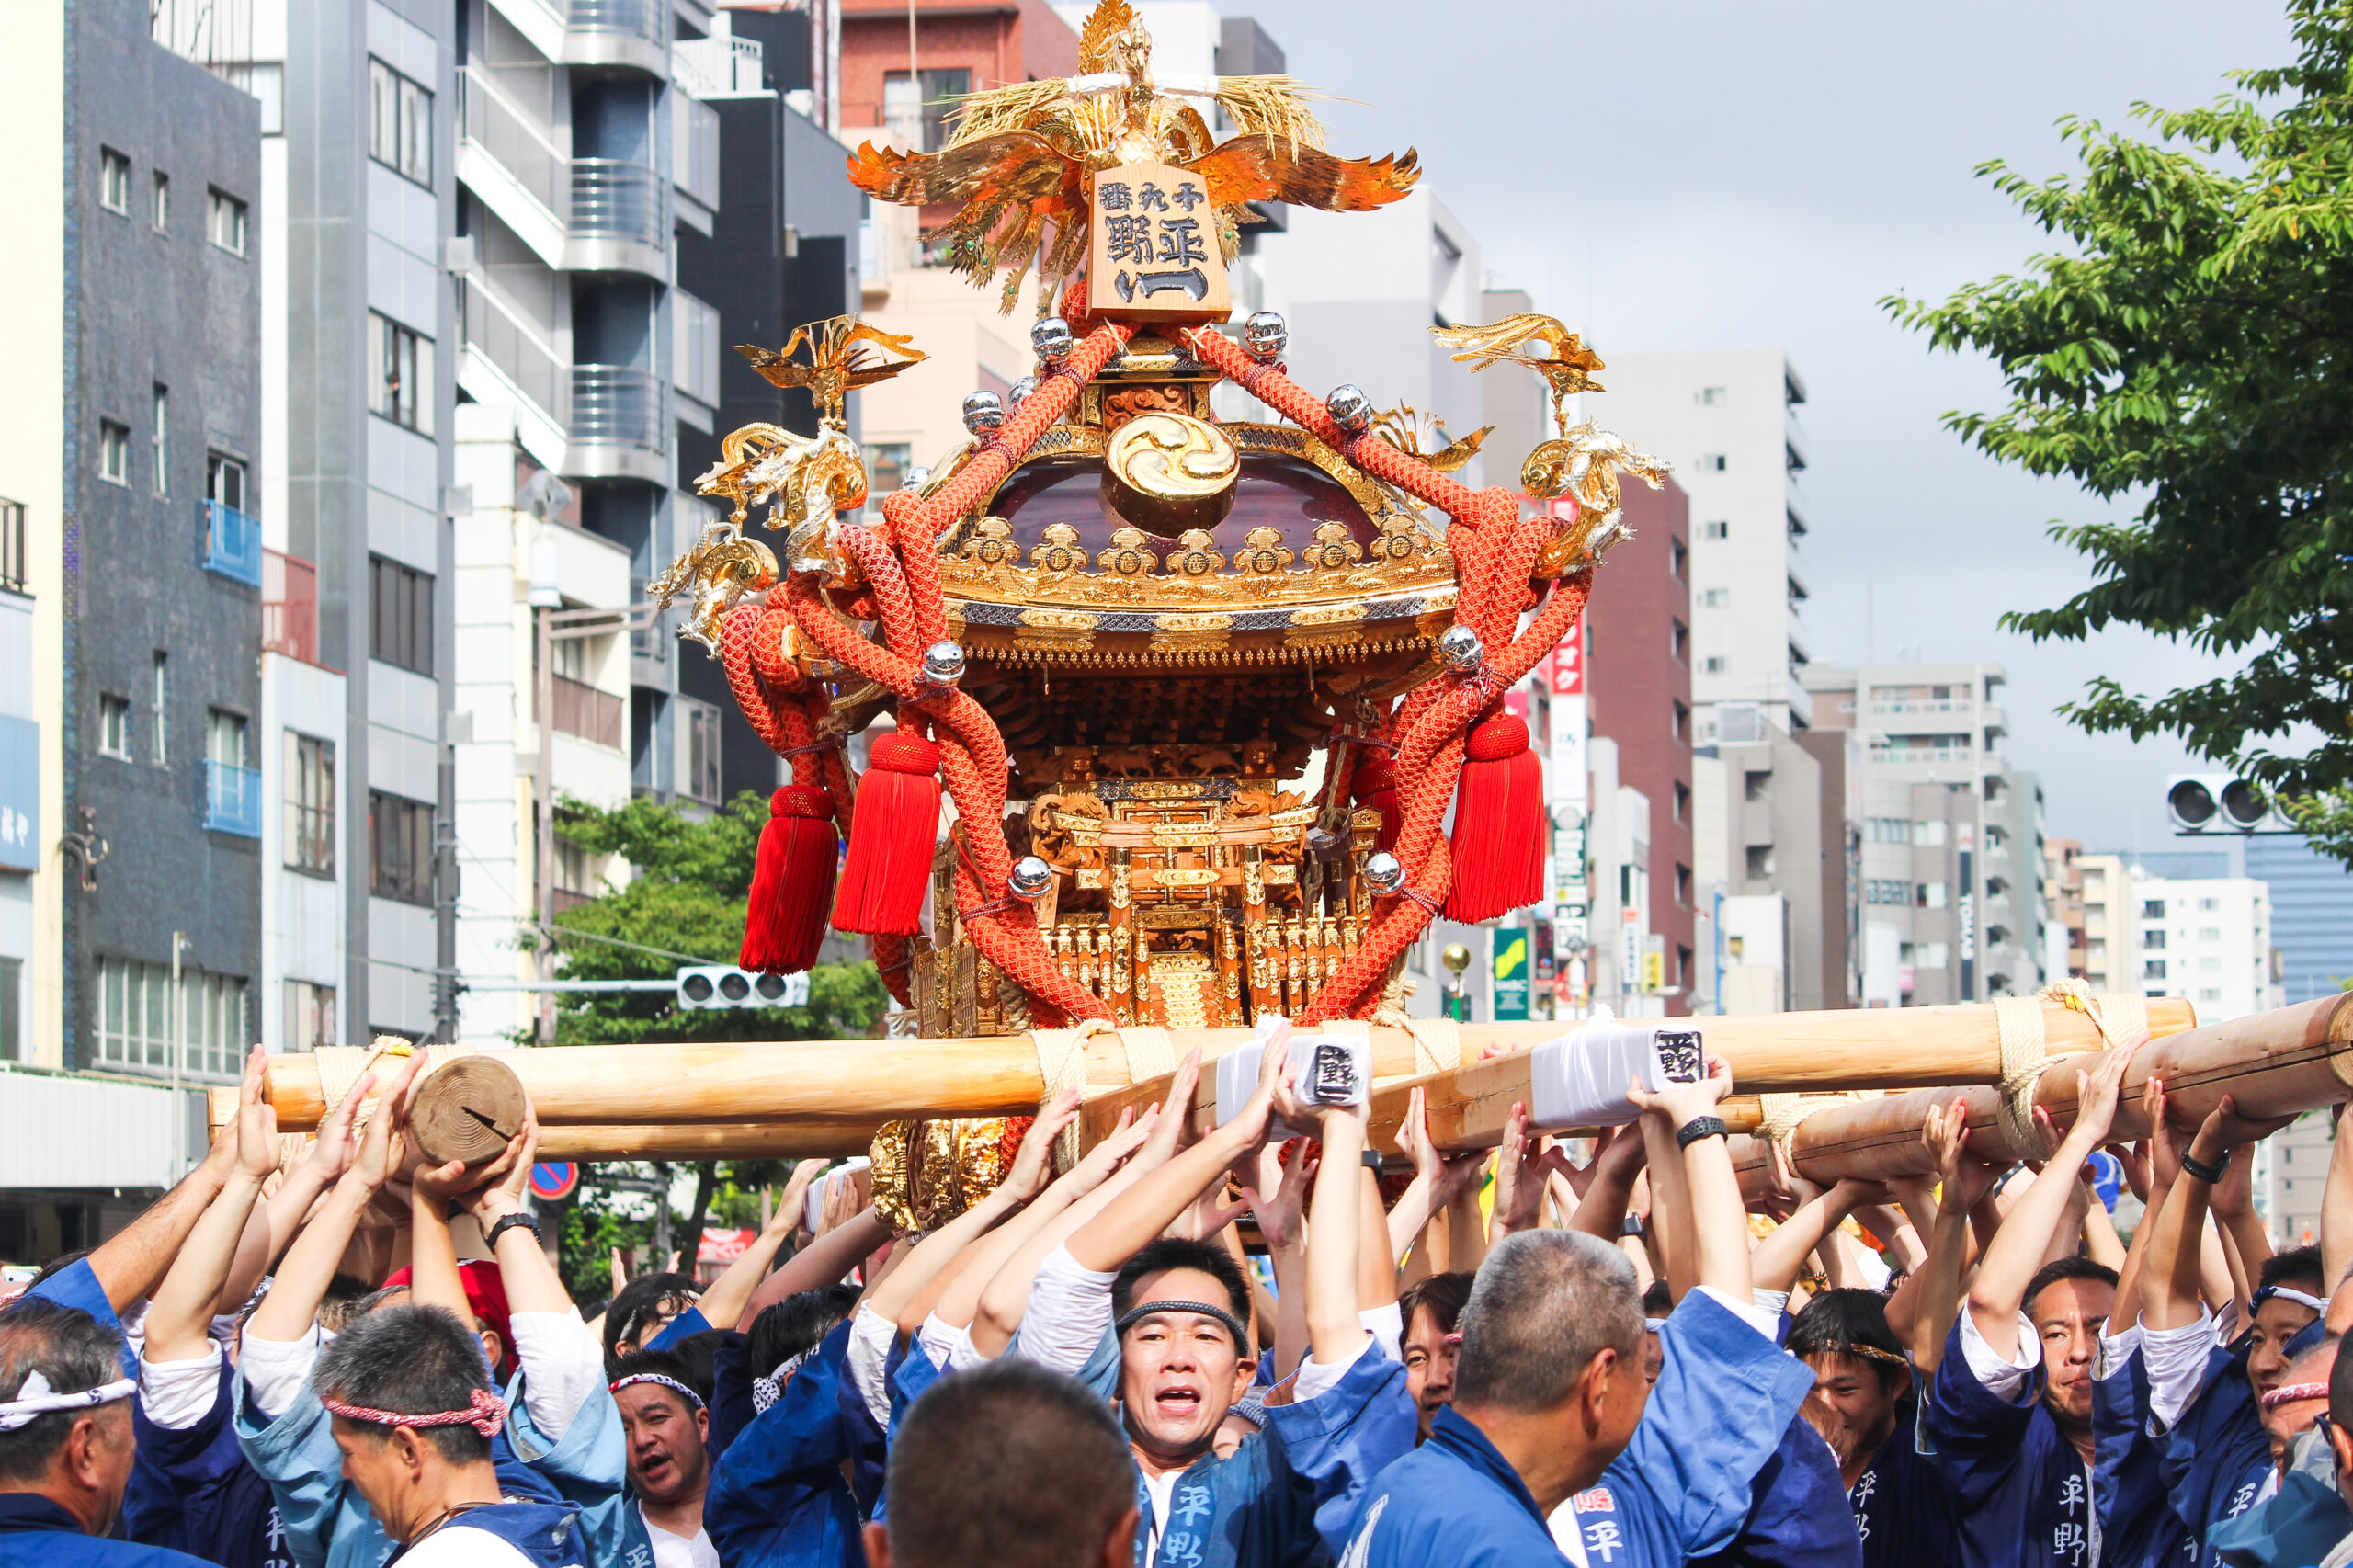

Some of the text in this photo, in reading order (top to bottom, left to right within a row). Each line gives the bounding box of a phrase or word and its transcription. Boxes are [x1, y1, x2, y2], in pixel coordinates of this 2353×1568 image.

[1162, 1485, 1211, 1568] 平野
[1583, 1519, 1624, 1563] 平
[2053, 1474, 2086, 1568] 平野
